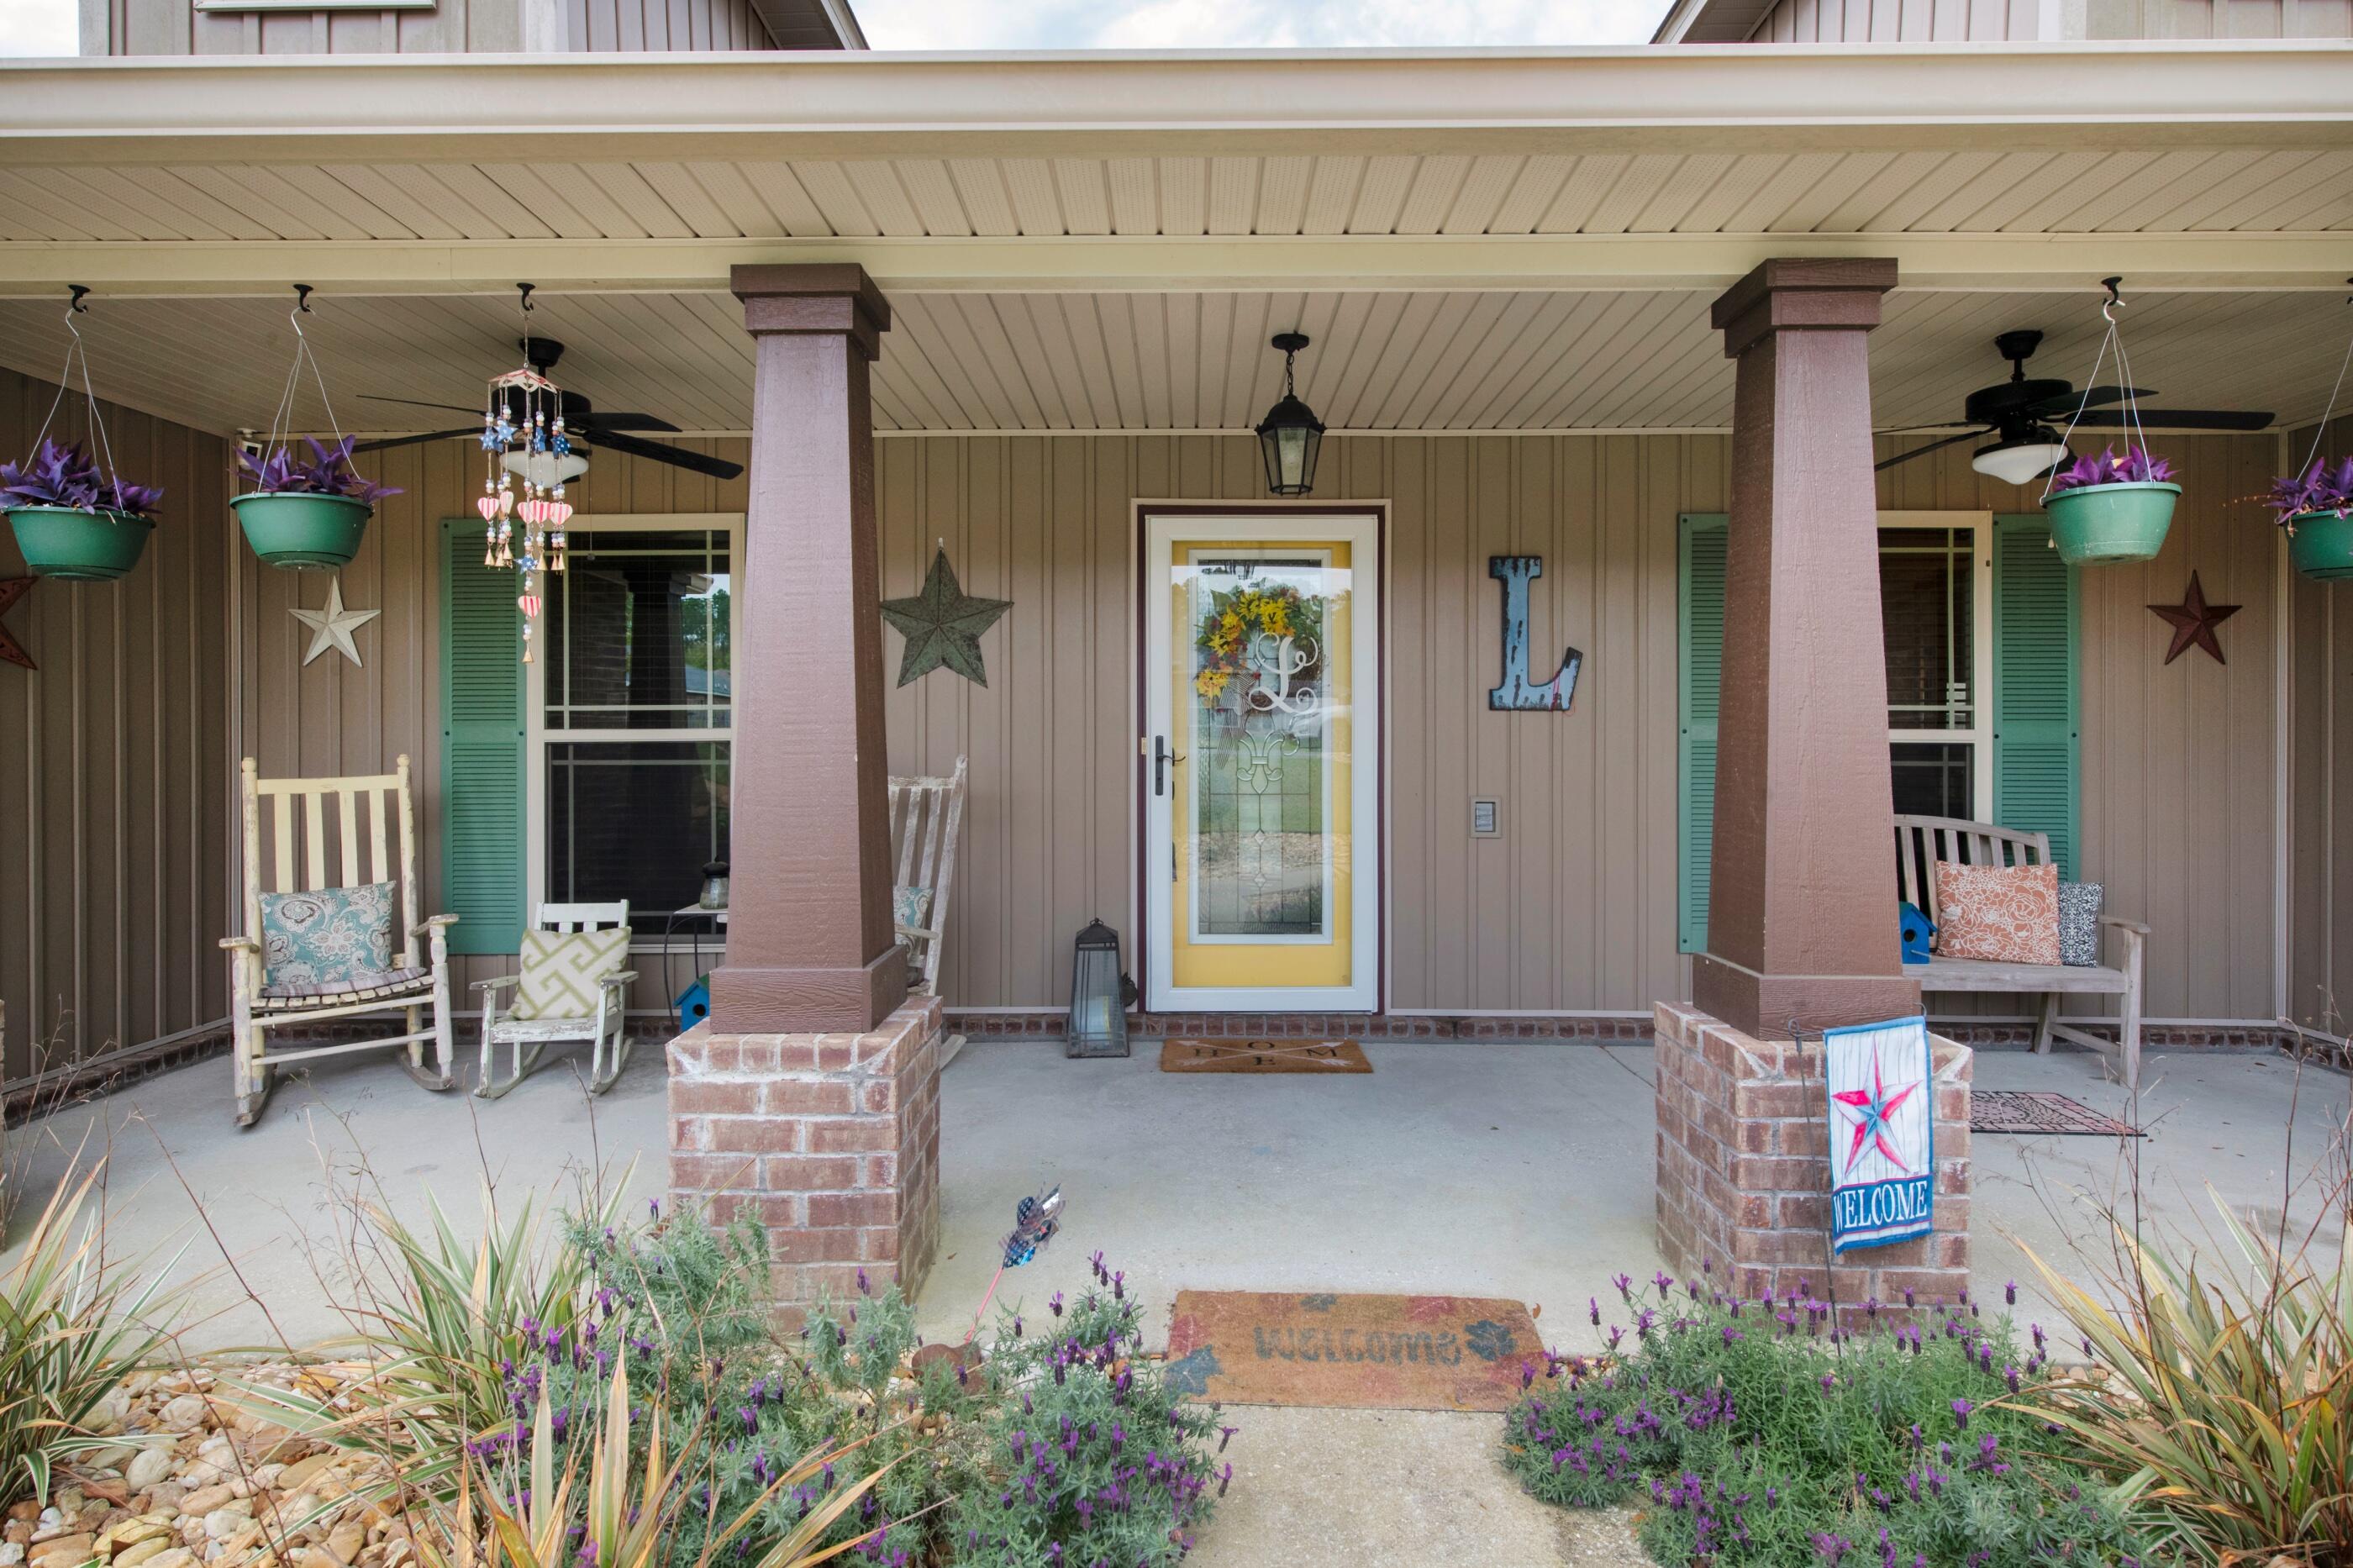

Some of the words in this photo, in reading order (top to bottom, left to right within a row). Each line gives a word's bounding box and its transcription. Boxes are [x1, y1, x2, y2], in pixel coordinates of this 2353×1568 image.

[1248, 632, 1319, 715] L
[1488, 555, 1584, 712] L
[1834, 1181, 1928, 1233] WELCOME
